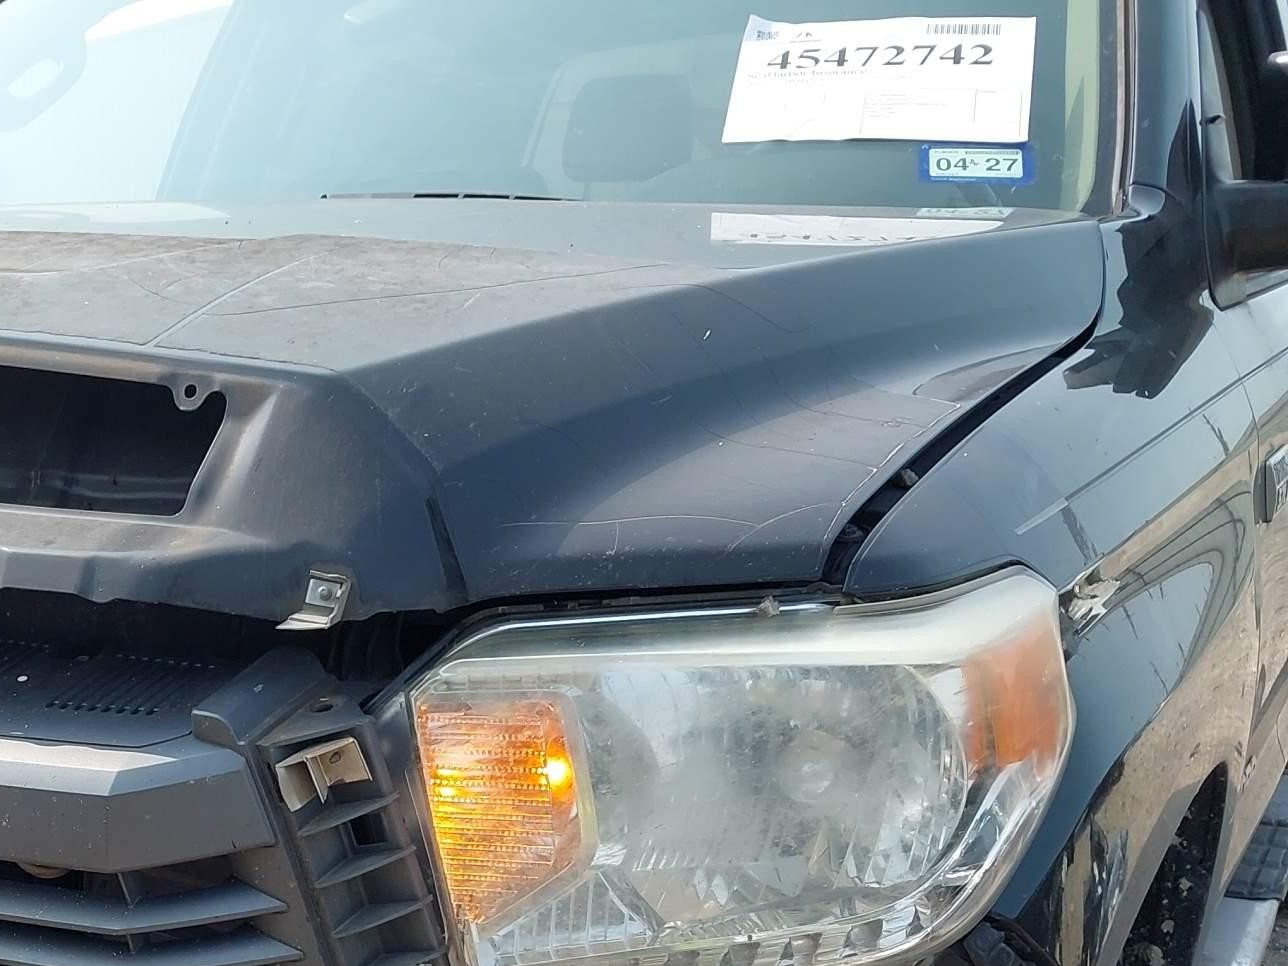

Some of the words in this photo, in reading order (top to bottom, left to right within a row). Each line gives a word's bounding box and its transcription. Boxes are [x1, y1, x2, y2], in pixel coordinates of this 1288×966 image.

[766, 43, 994, 70] 45472742
[935, 157, 969, 172] 04
[985, 157, 1019, 172] 27
